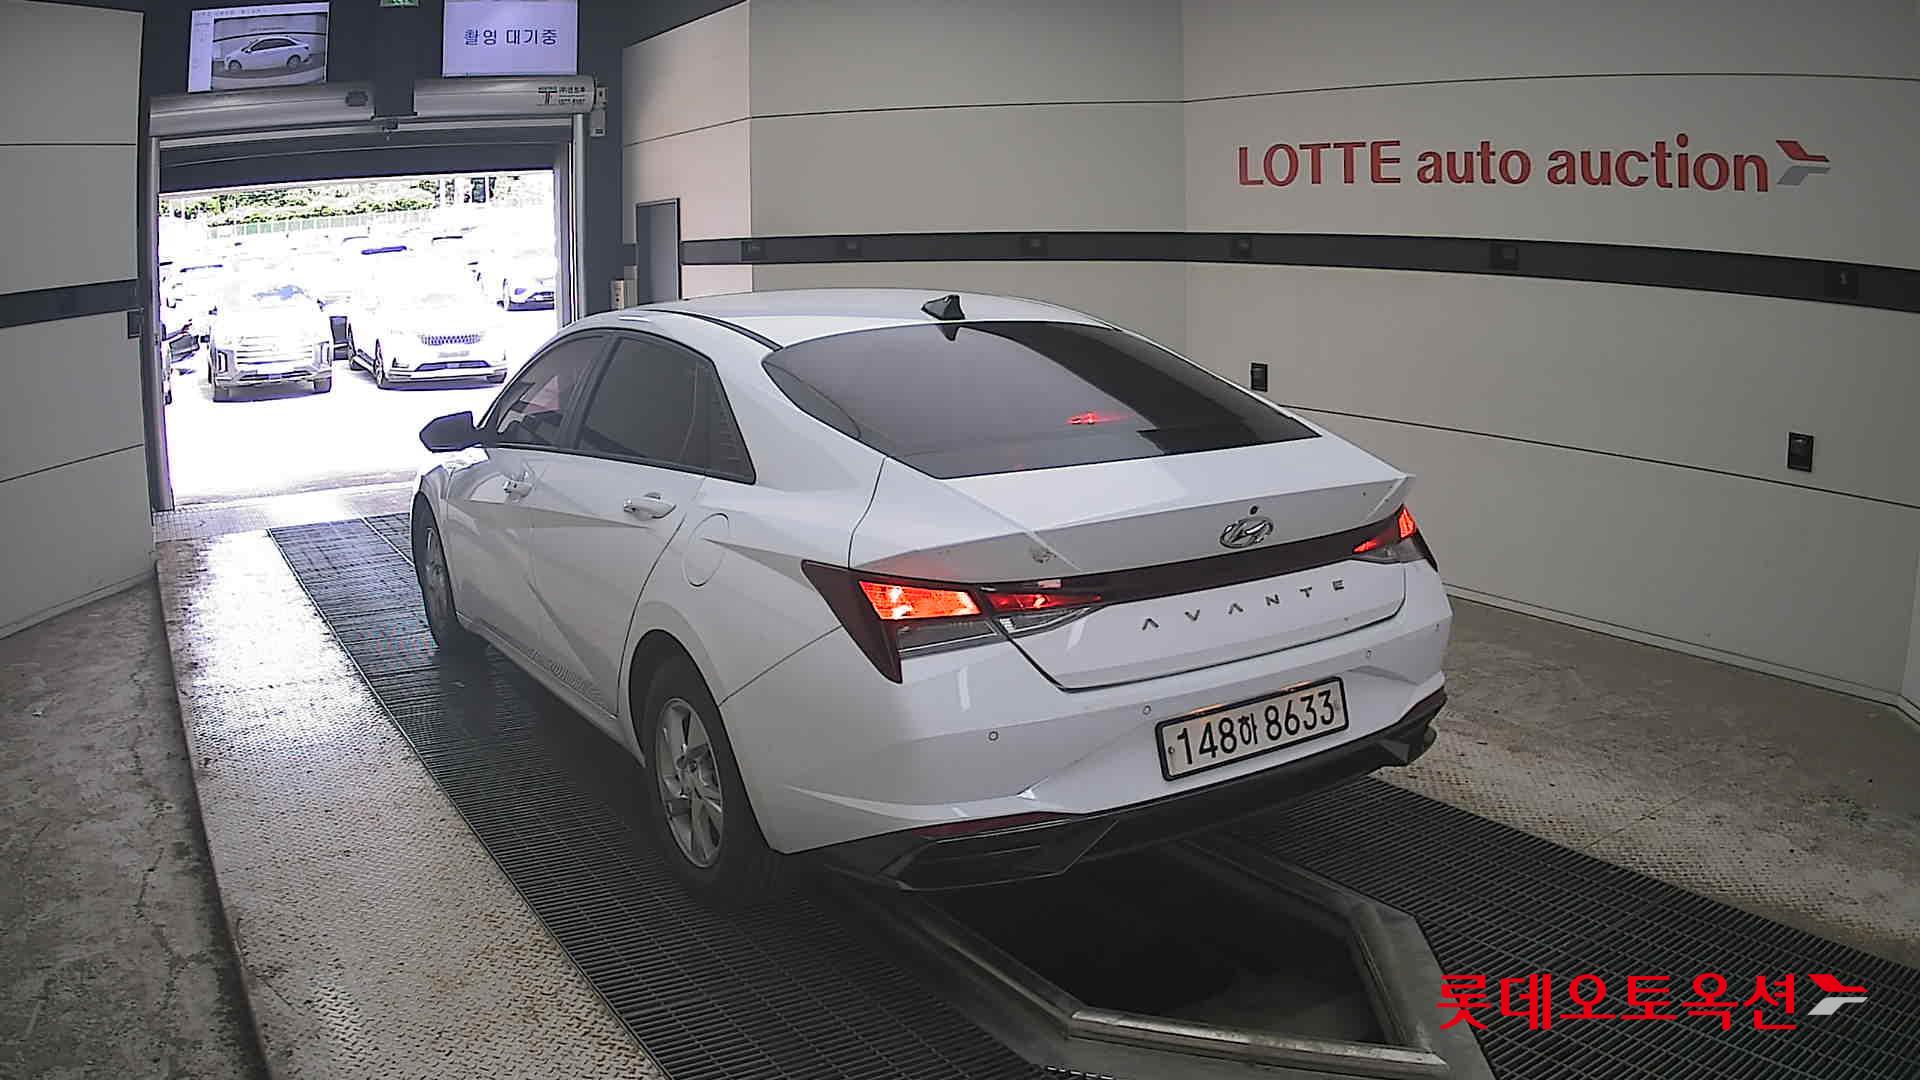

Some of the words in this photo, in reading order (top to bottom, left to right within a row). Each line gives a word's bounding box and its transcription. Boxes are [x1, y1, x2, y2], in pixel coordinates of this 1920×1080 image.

[505, 29, 557, 46] 대기중
[1238, 140, 1400, 187] LOTTE
[1416, 140, 1532, 185] auto
[1546, 133, 1769, 193] auction
[1142, 579, 1345, 631] AVANTE
[1264, 689, 1335, 741] 8633
